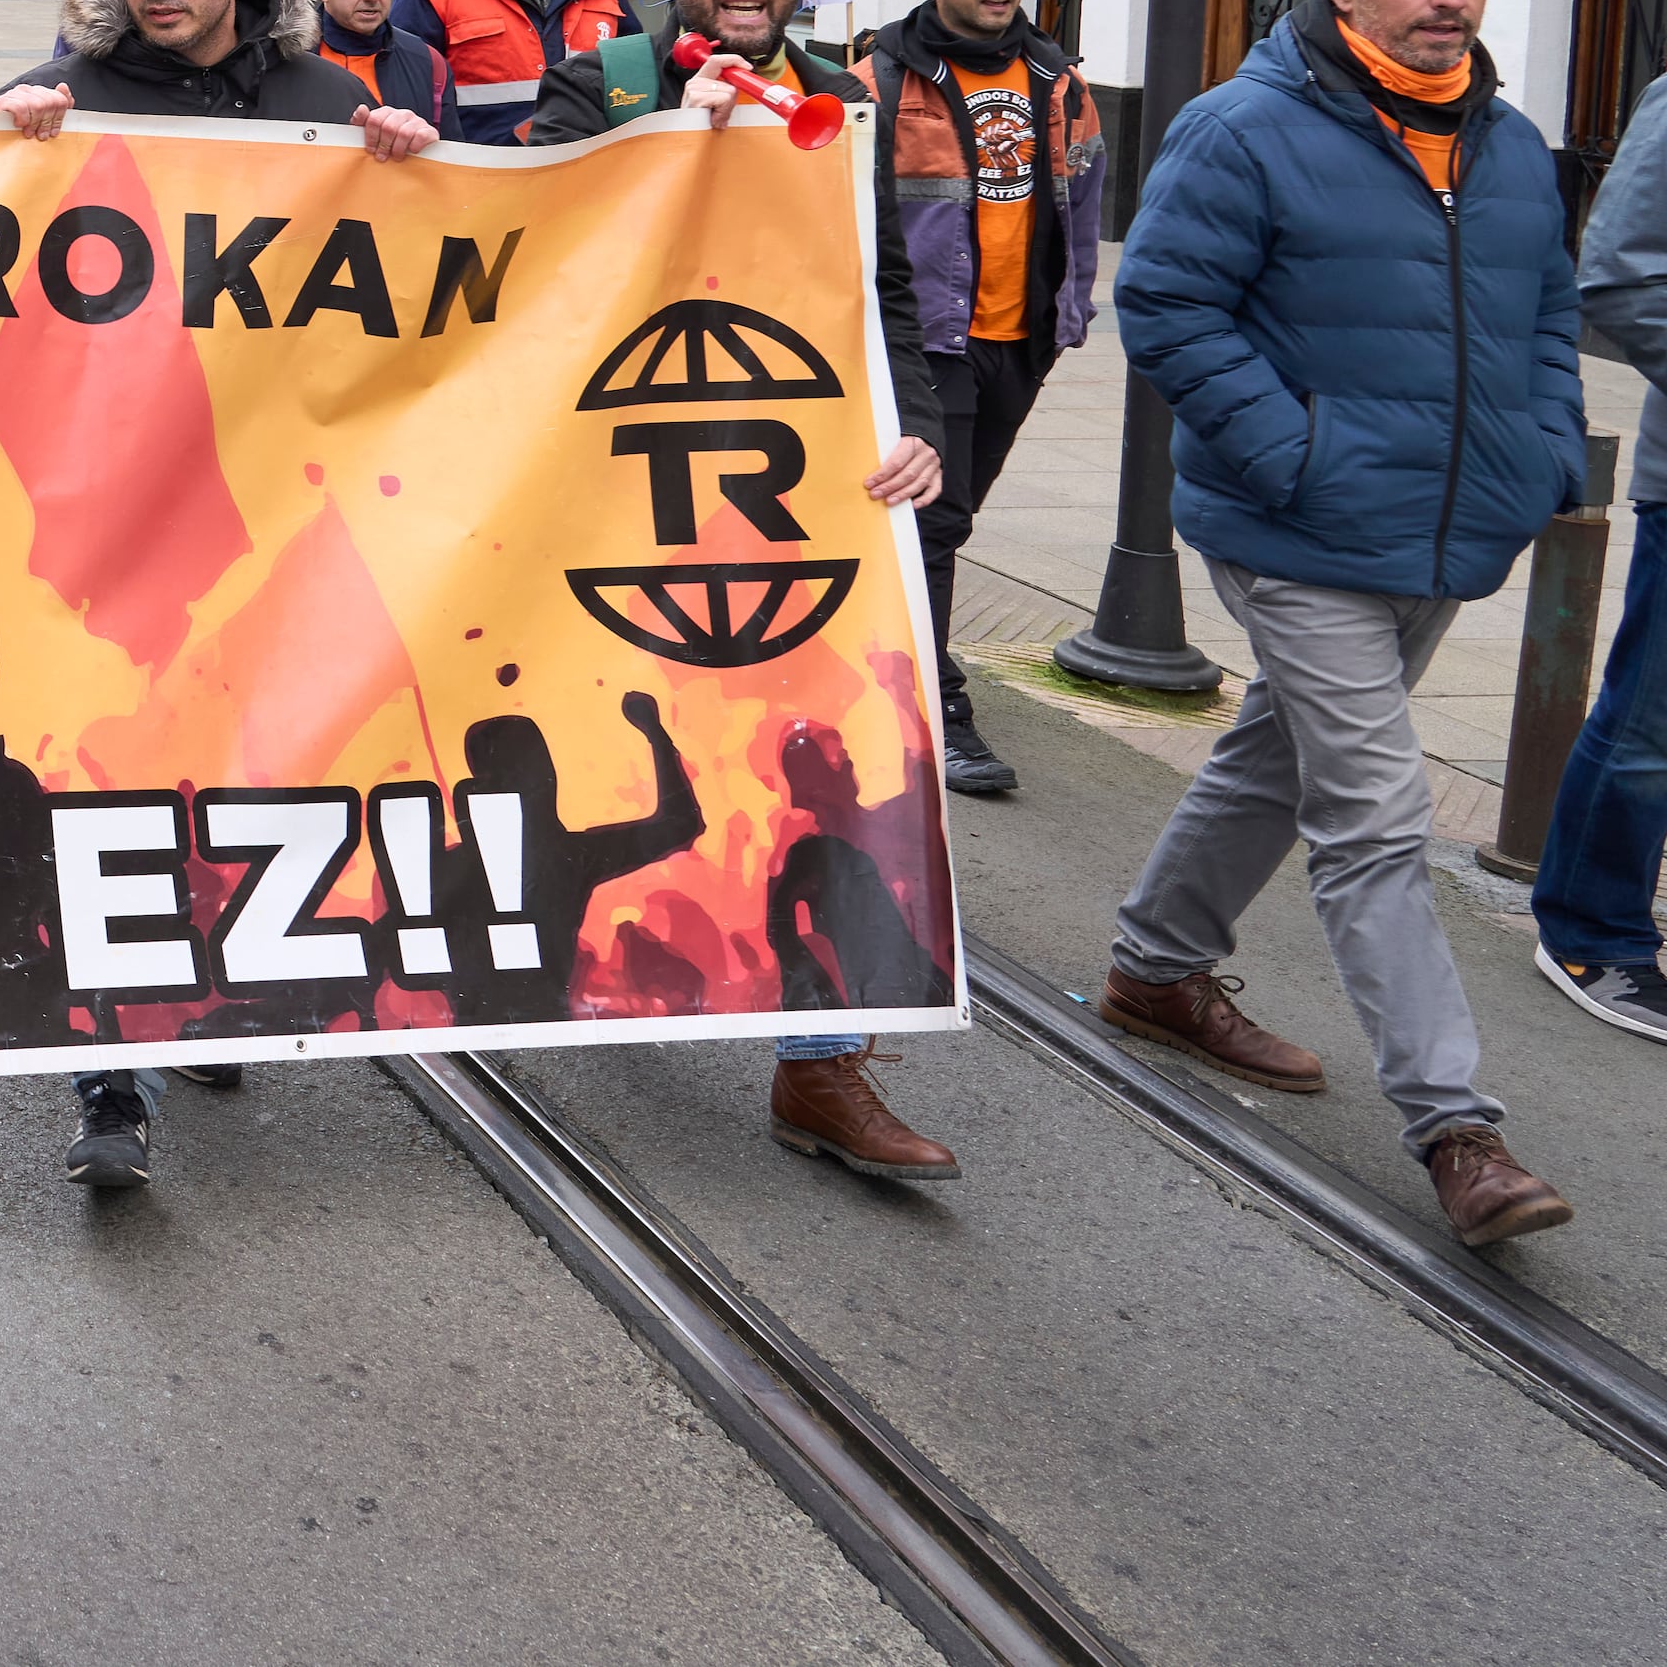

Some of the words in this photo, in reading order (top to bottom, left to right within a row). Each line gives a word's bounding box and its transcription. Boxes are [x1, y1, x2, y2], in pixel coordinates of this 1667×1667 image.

[975, 111, 993, 127] NO
[1017, 164, 1032, 177] EZ
[610, 419, 809, 548] TR
[50, 791, 544, 991] EZ!!
